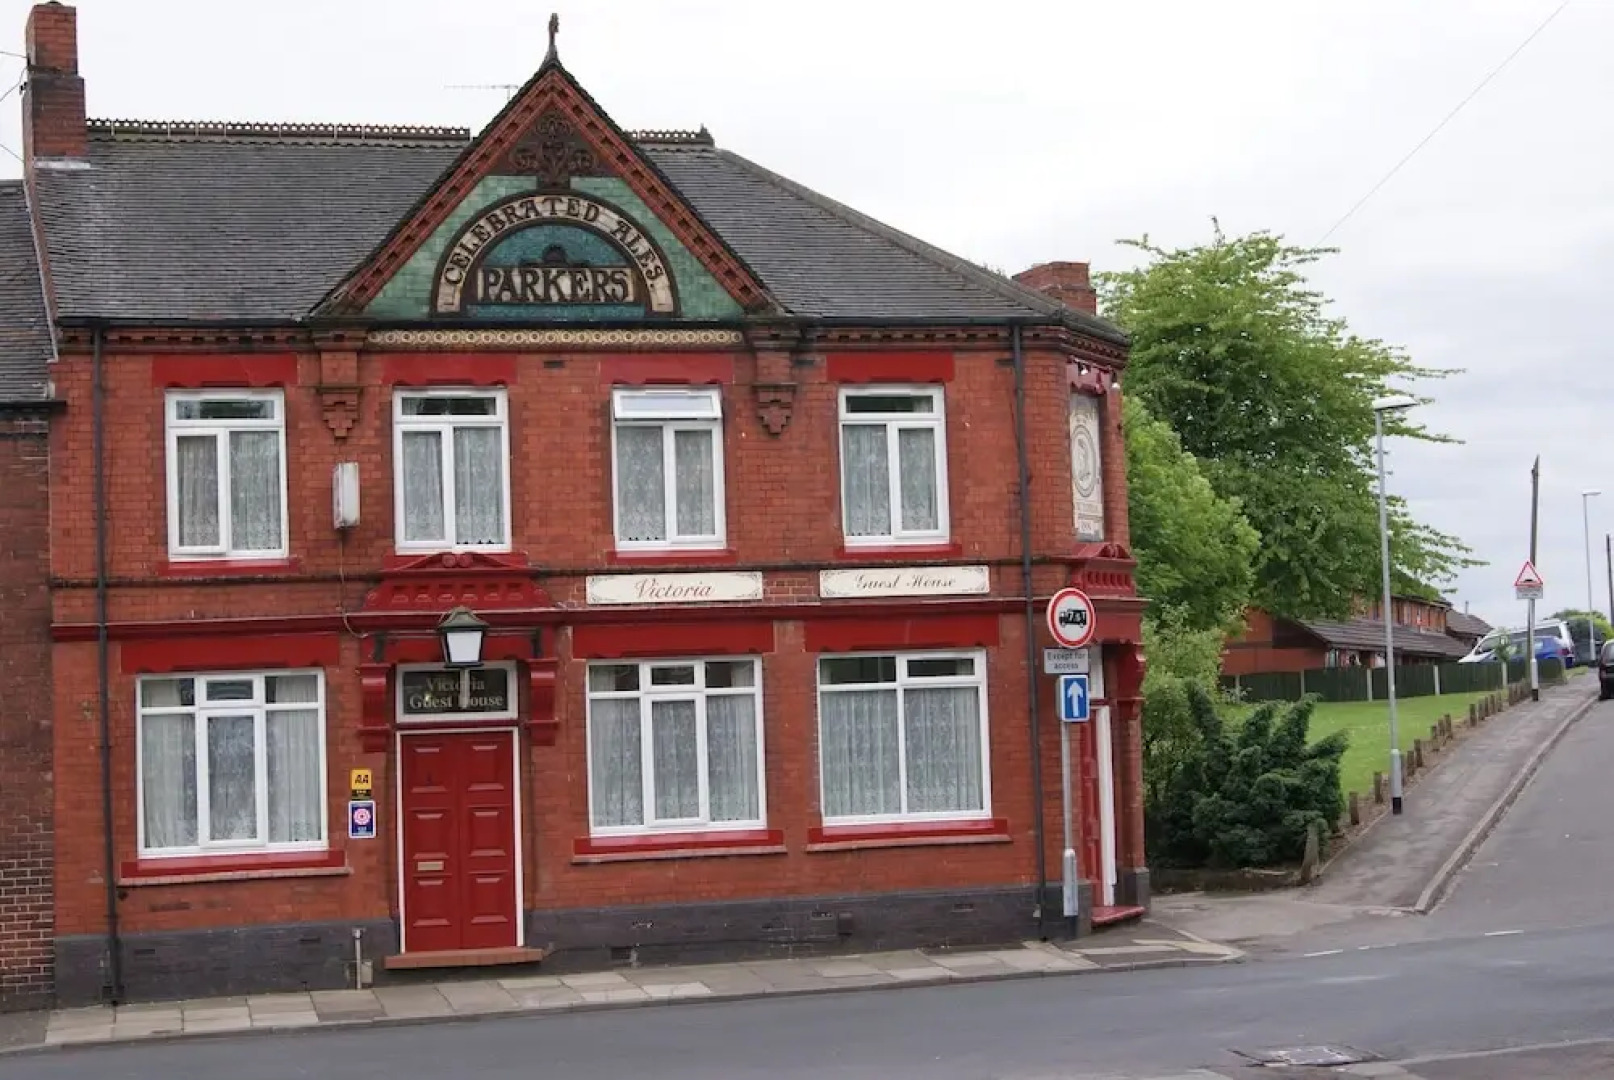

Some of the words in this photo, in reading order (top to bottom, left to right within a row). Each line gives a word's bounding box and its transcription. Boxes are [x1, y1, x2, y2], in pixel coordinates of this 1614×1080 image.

[443, 197, 601, 285] CELEBRATED
[482, 268, 629, 302] PARKERS
[634, 577, 713, 599] Victoria
[855, 573, 901, 590] Guest
[906, 572, 957, 588] House
[1047, 651, 1073, 661] Except
[1075, 651, 1086, 660] for
[425, 676, 485, 692] Victia
[409, 693, 453, 709] Guest
[355, 774, 369, 784] AA
